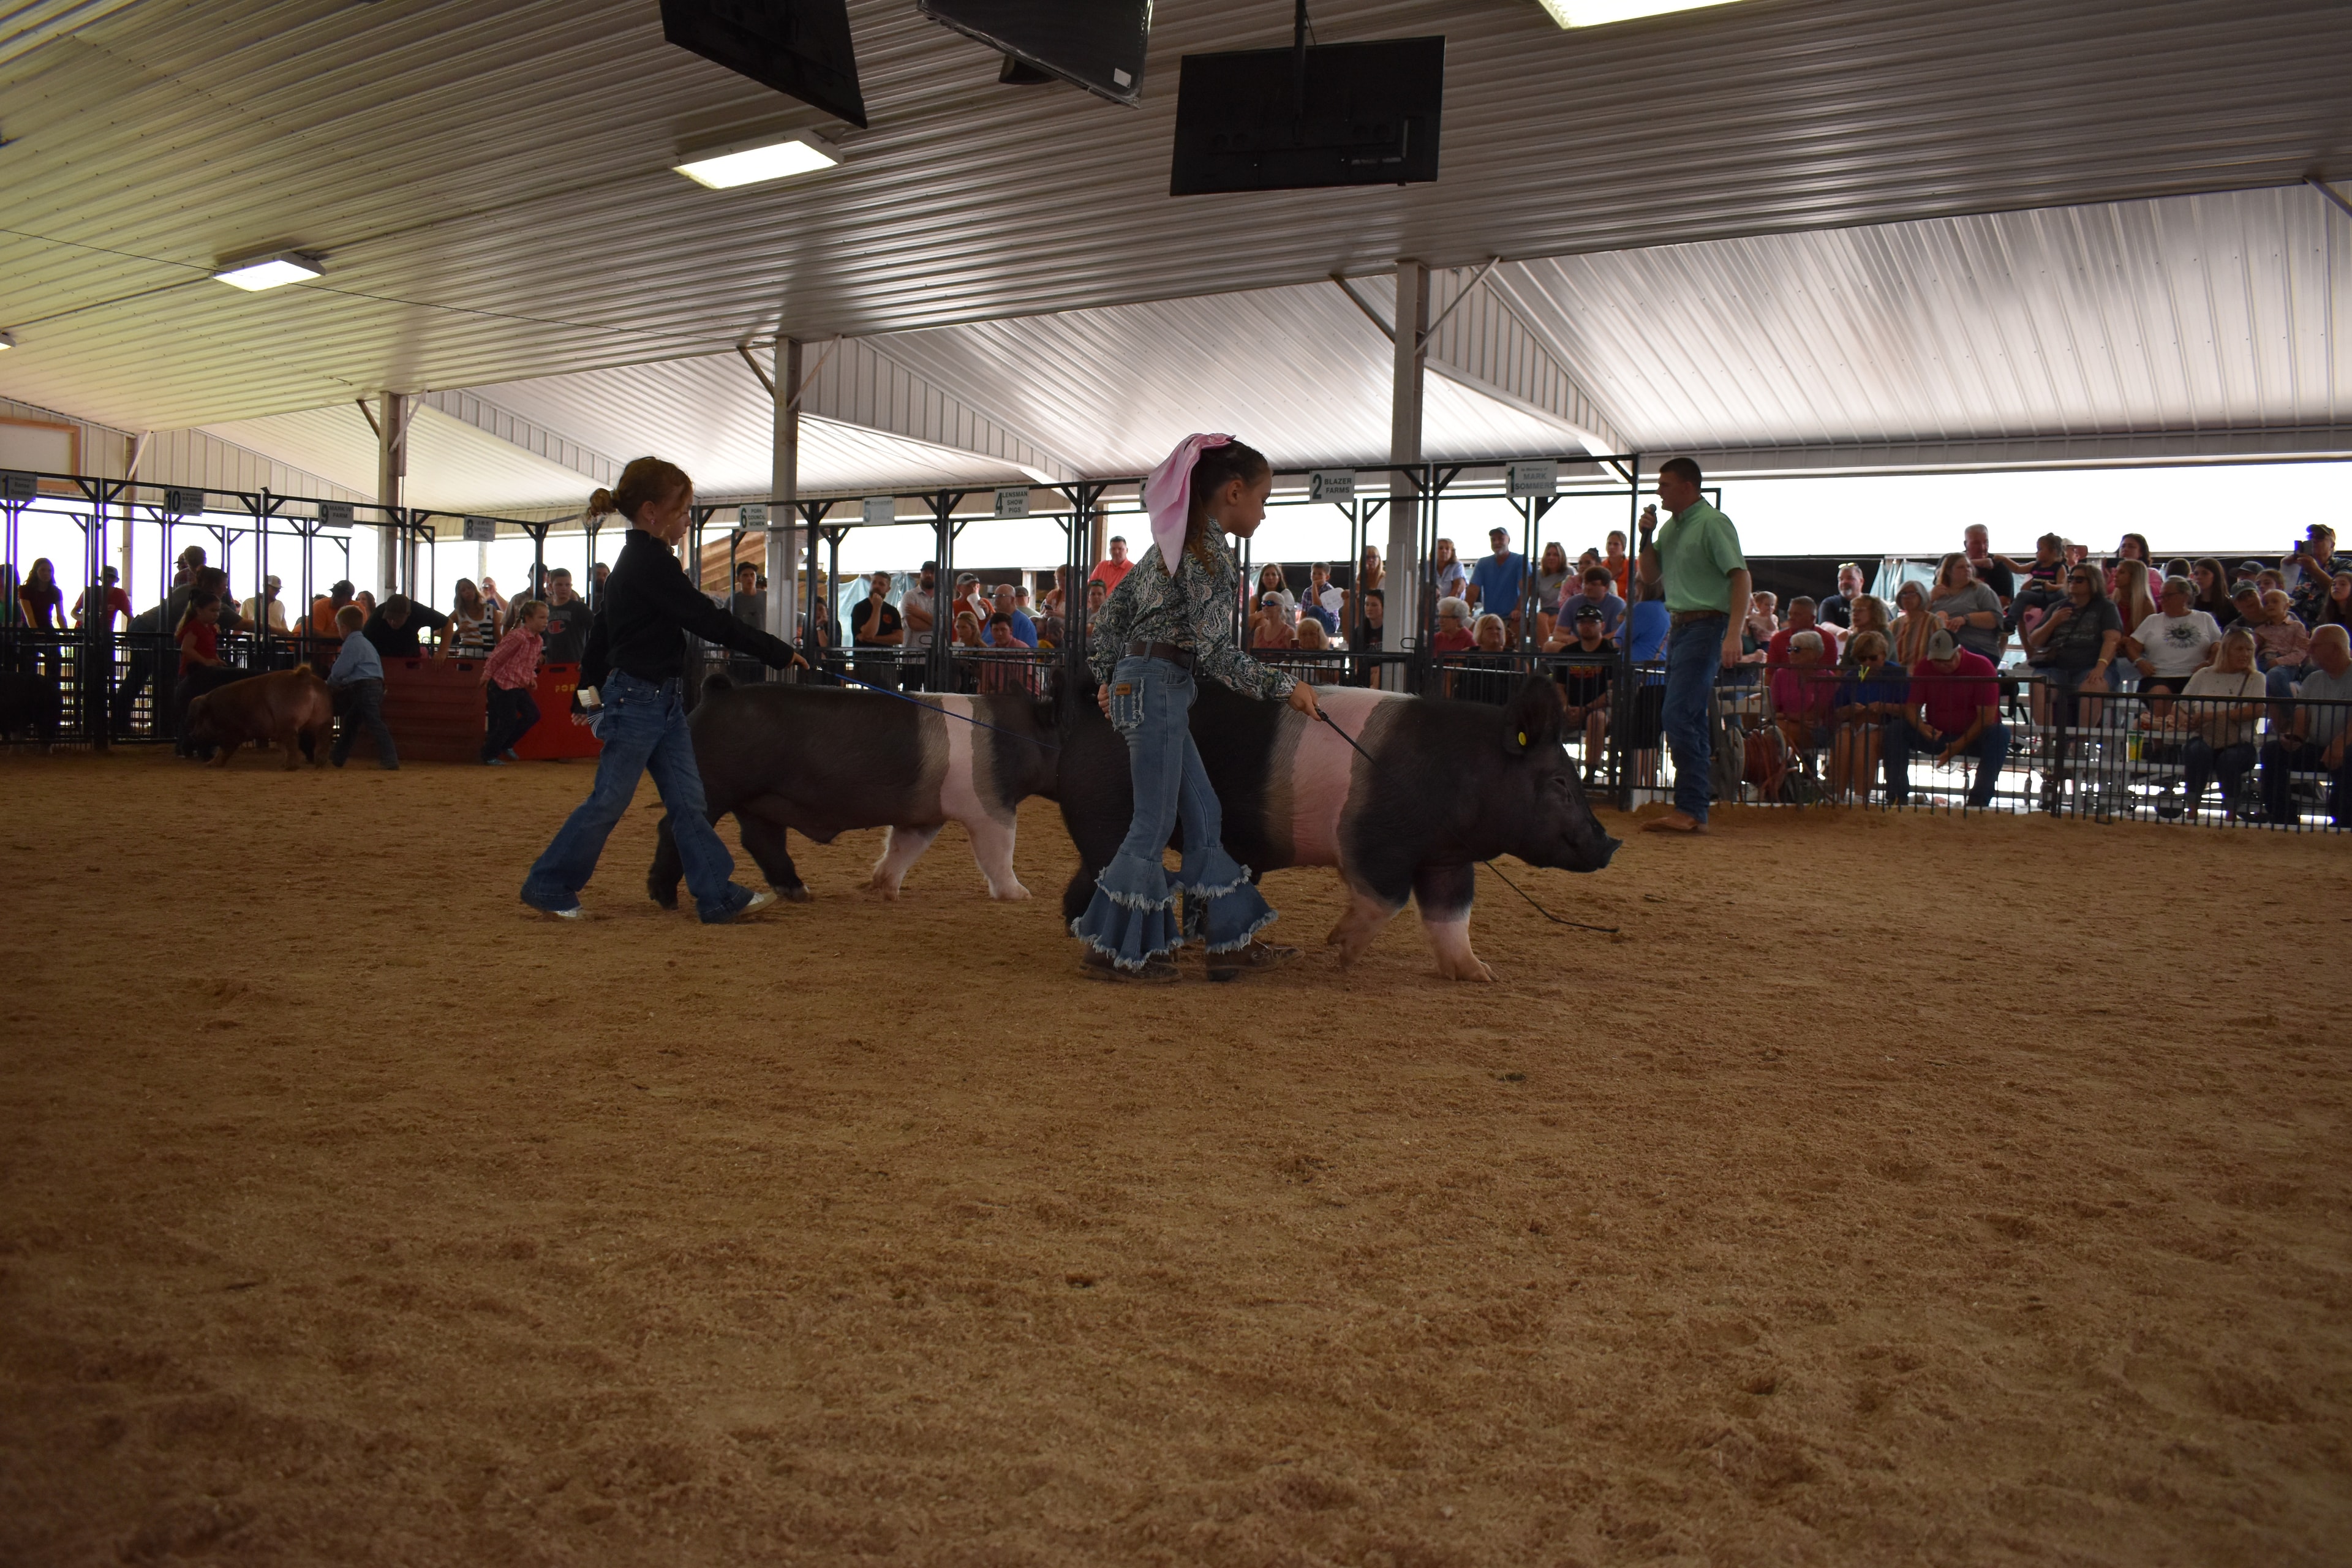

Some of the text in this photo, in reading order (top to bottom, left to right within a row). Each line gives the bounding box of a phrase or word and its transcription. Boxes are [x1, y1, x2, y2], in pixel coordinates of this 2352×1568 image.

[1313, 473, 1322, 499] 2
[1508, 467, 1515, 493] 1
[167, 491, 181, 511] 10
[996, 492, 1003, 514] 4
[322, 505, 328, 524] 9
[741, 508, 747, 528] 6
[864, 501, 870, 522] 5
[467, 519, 473, 538] 8
[556, 683, 578, 692] POR
